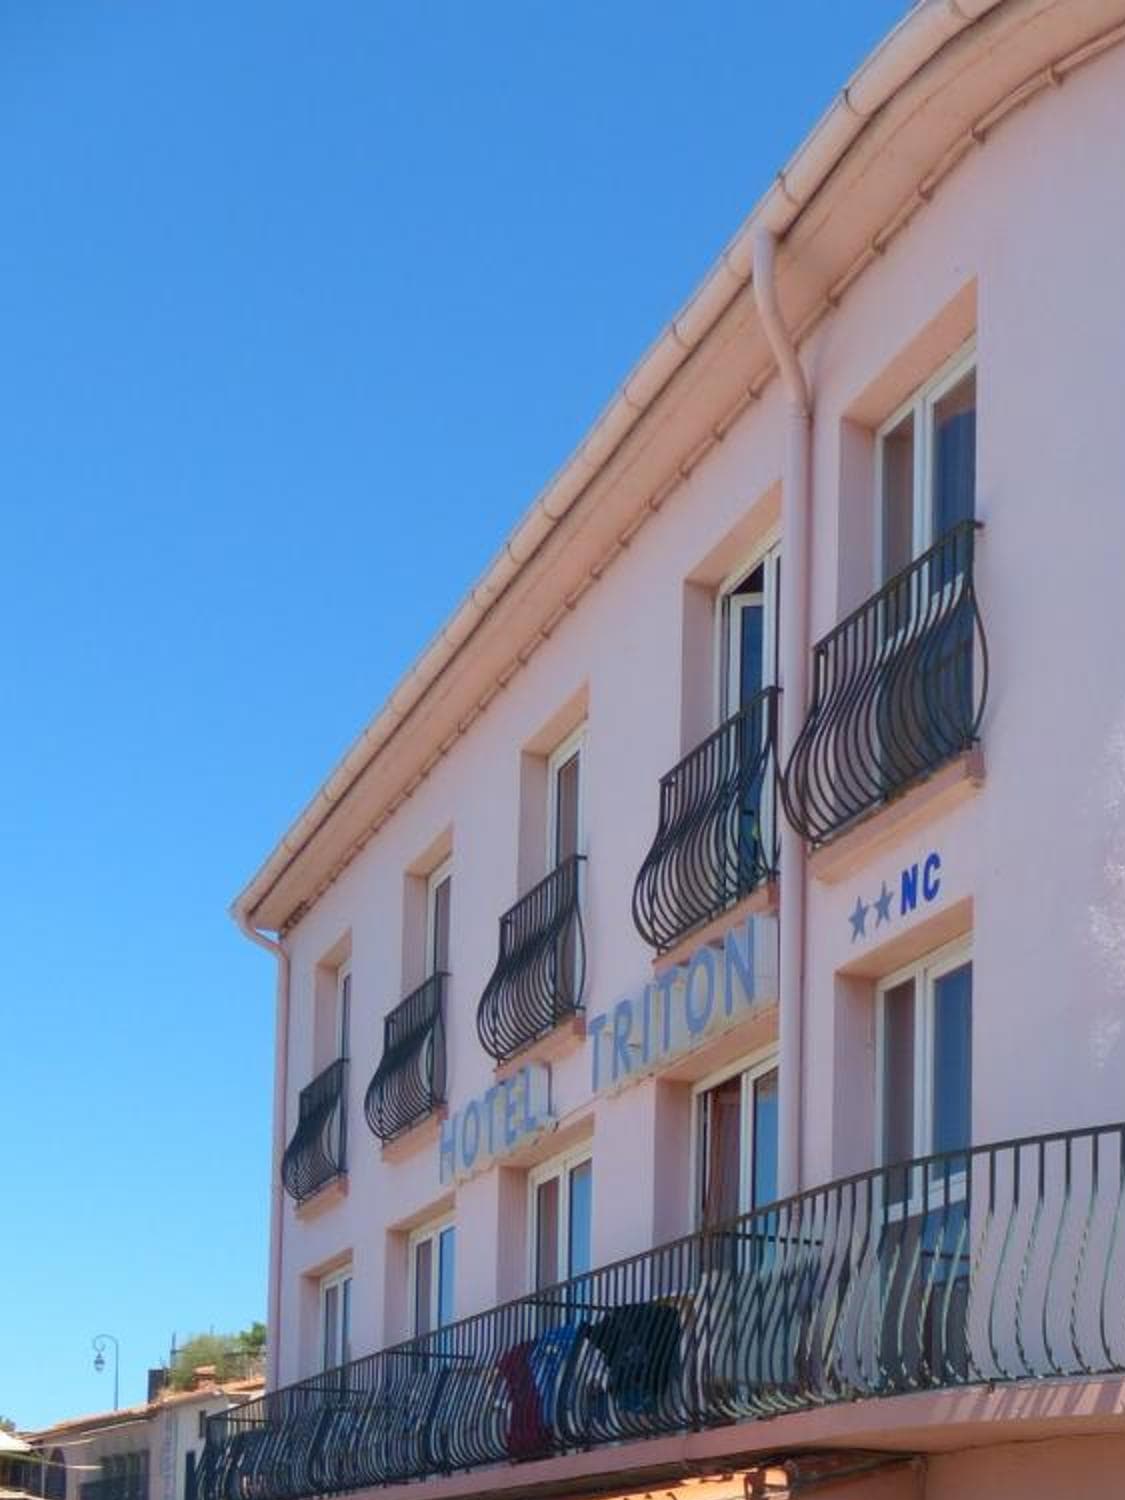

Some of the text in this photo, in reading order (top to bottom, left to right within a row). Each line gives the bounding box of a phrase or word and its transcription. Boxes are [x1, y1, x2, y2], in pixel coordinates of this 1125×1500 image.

[900, 852, 942, 915] NC
[439, 912, 757, 1184] HOTEL TRITON
